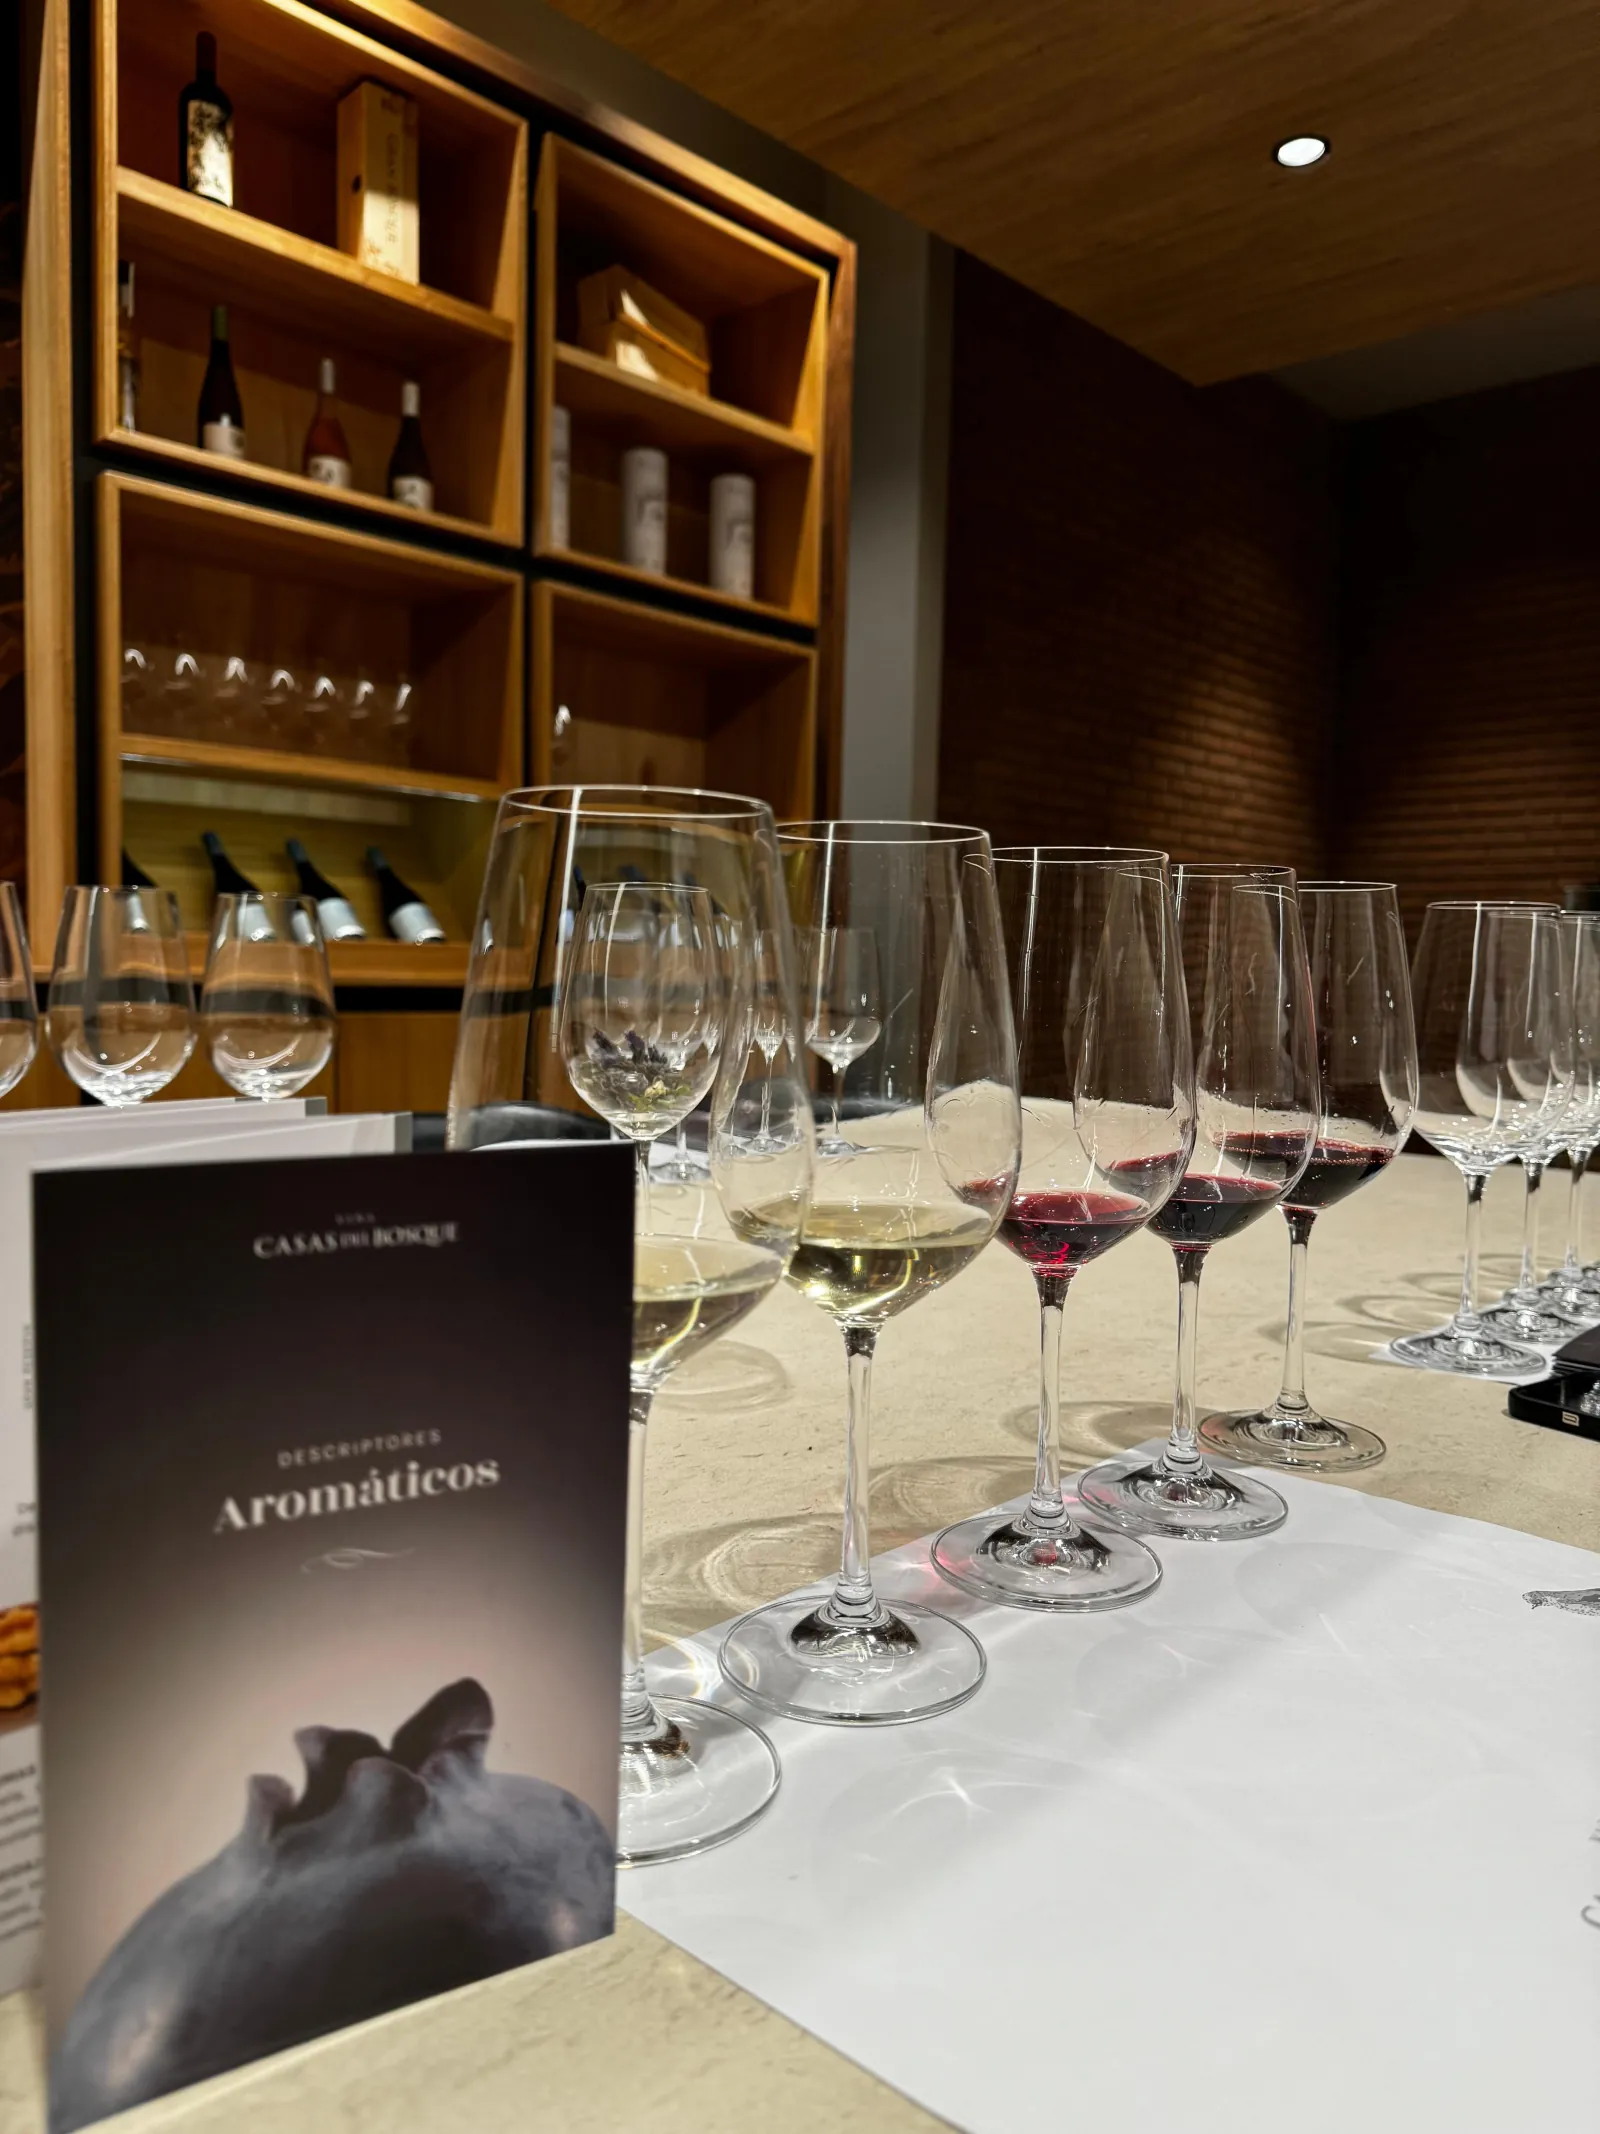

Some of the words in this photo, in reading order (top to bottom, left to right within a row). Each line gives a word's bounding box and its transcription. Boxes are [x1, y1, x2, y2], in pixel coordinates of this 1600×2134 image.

[253, 1231, 338, 1259] CASAS
[277, 1428, 442, 1468] DESCRIPTORES
[213, 1458, 501, 1535] Aromáticos
